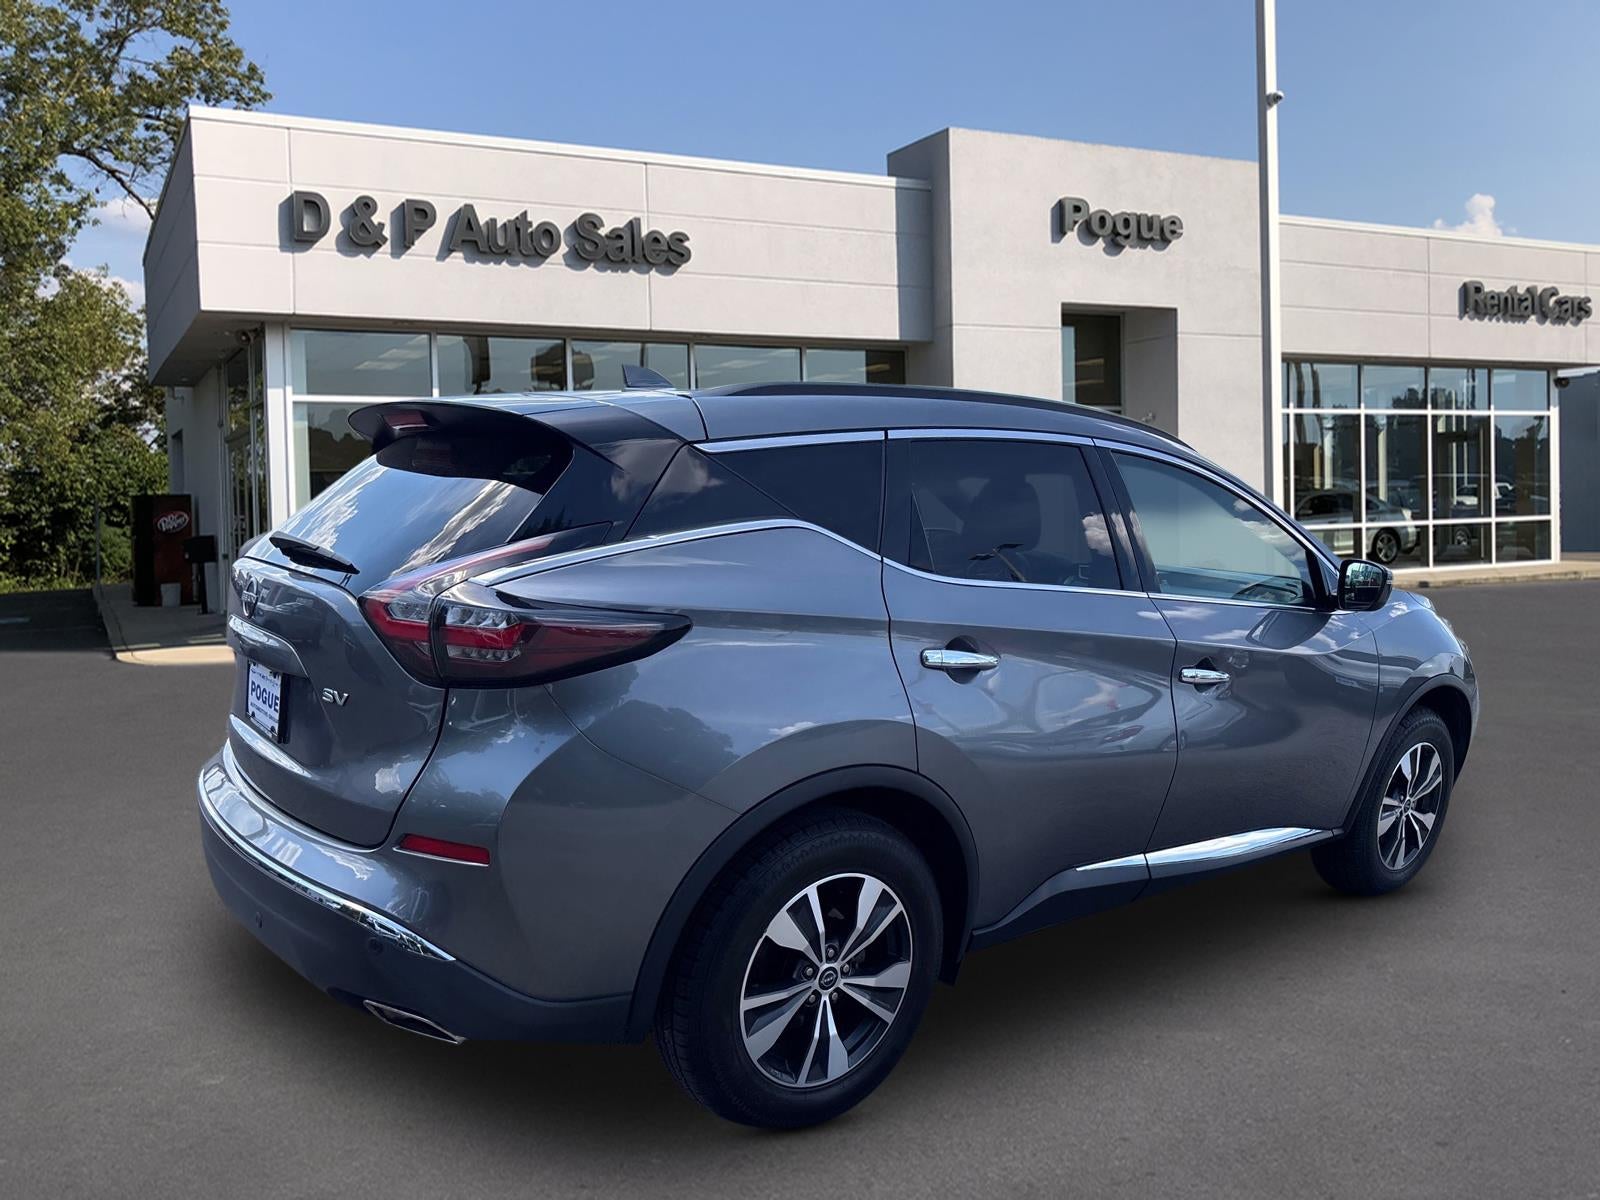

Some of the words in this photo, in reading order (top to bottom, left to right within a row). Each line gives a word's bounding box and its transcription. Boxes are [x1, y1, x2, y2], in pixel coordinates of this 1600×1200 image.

[291, 190, 331, 244] D
[346, 195, 388, 249] &
[400, 198, 437, 249] P
[447, 203, 562, 260] Auto
[573, 212, 692, 267] Sales
[1059, 197, 1184, 248] Pogue
[1463, 280, 1538, 318] Rental
[1539, 286, 1592, 321] Cars
[250, 680, 280, 714] POGUE
[322, 687, 349, 707] SV
